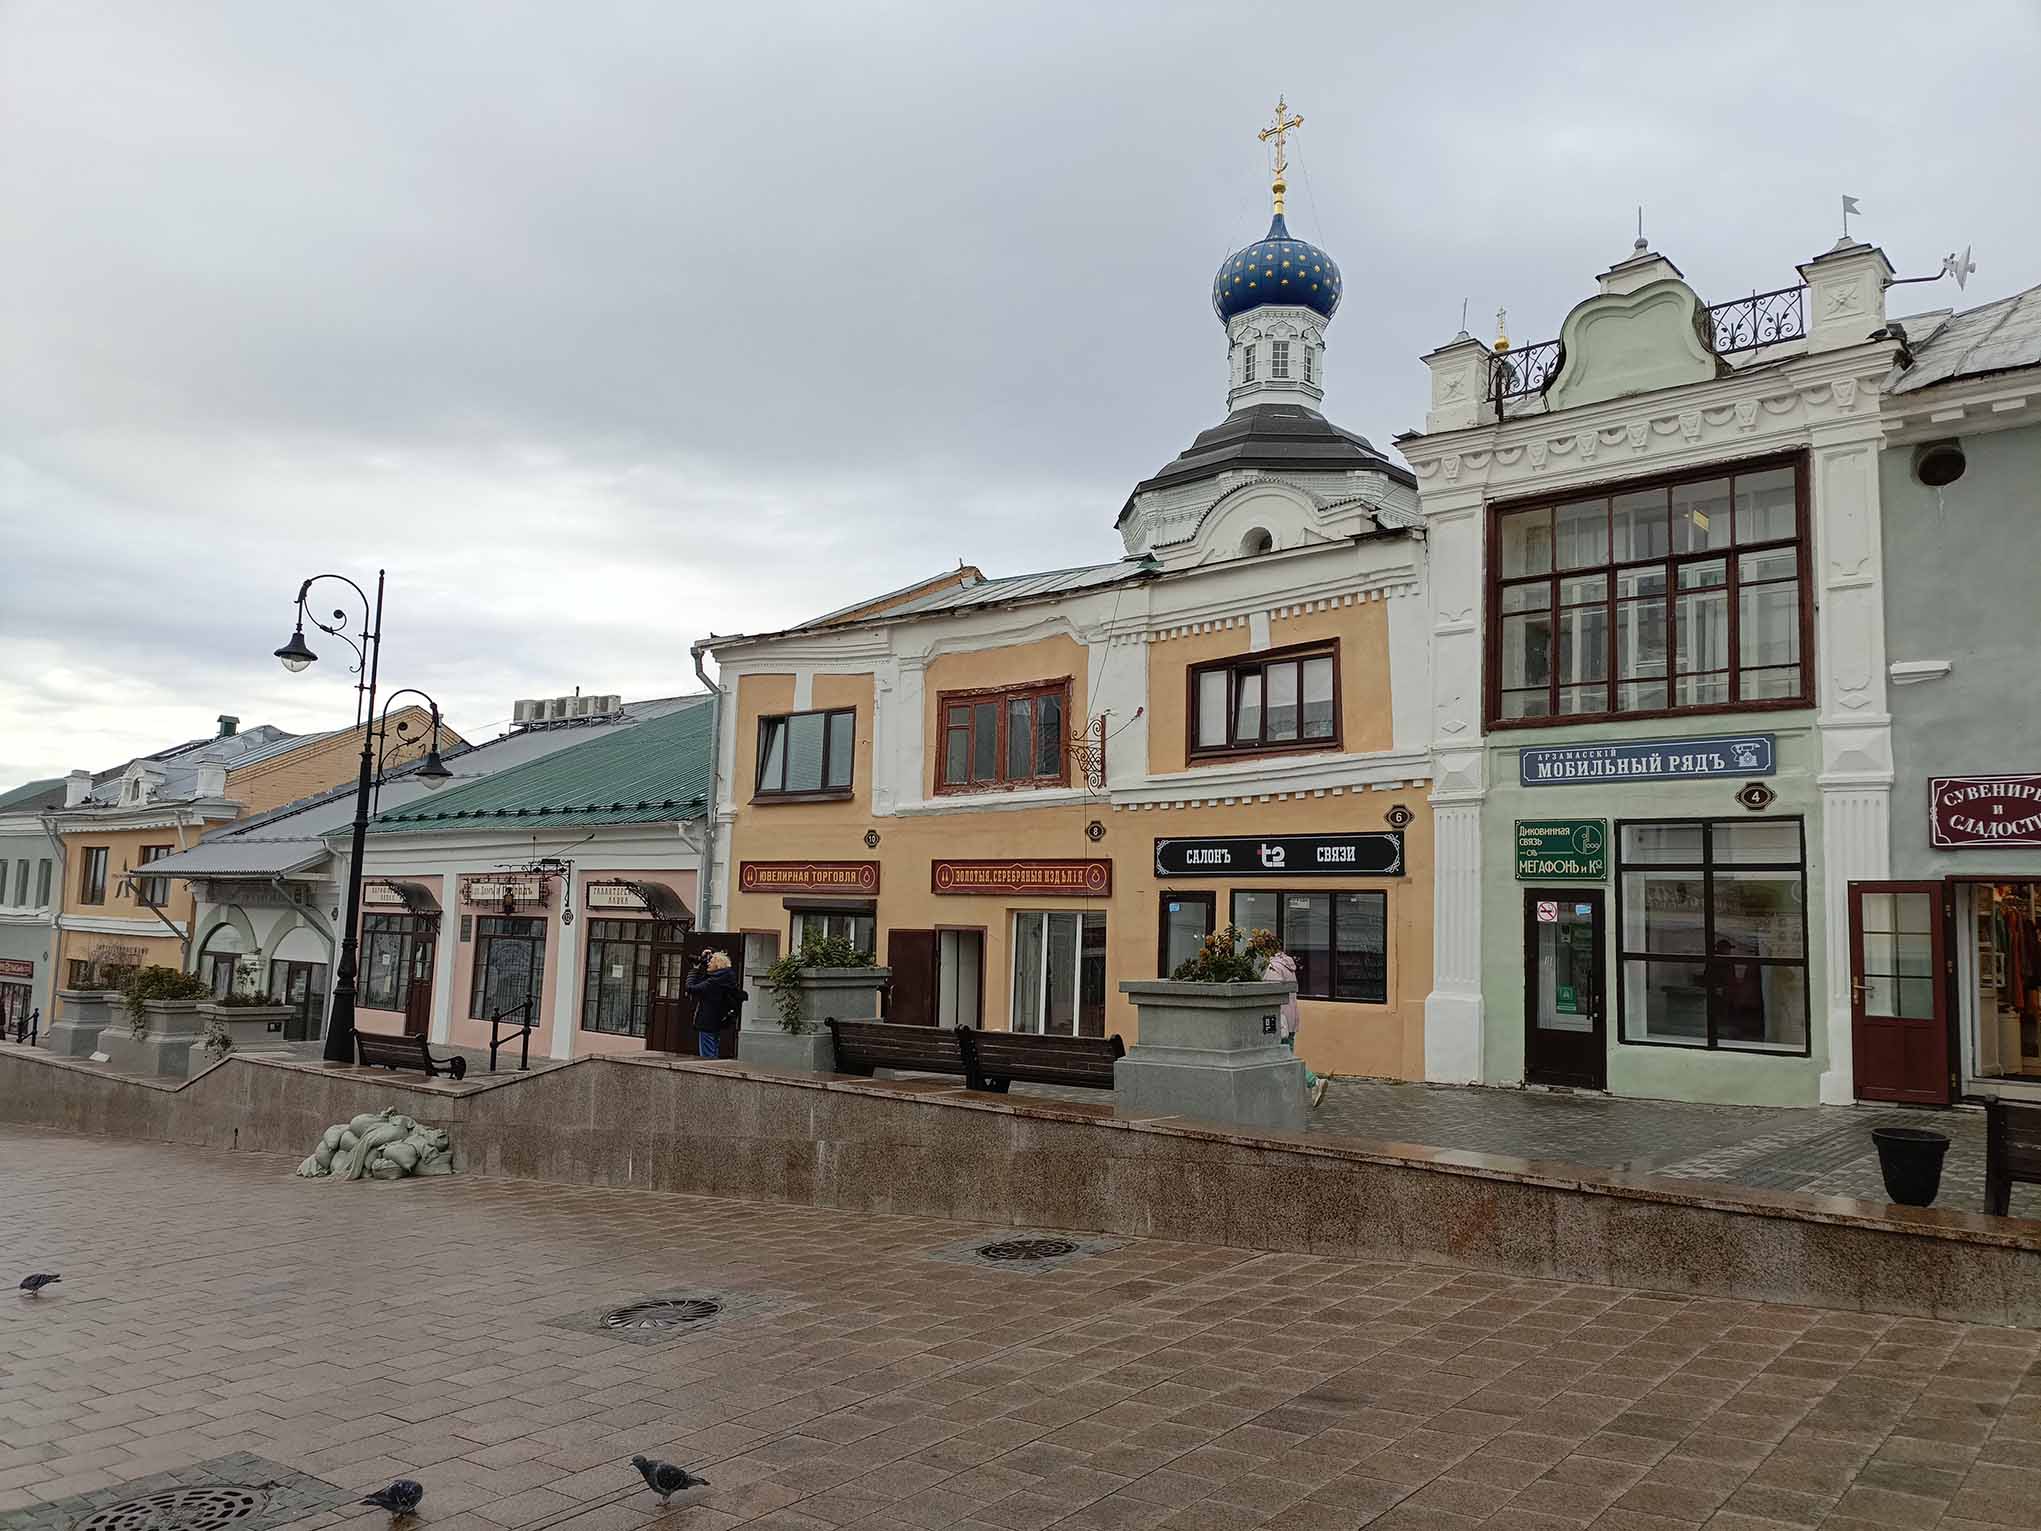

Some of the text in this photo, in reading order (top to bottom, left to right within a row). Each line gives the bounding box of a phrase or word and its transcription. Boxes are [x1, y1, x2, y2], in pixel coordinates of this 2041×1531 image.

[1537, 753, 1726, 778] МОБИЛЬНЫЙ РЯДЪ
[1752, 791, 1760, 802] 4
[1396, 812, 1402, 822] 6
[868, 835, 876, 843] 10
[1186, 849, 1231, 864] САЛОНЪ
[1317, 846, 1356, 862] СВЯЗИ
[759, 871, 856, 882] ЮВЕЛИРНАЯ ТОРГОВЛЯ
